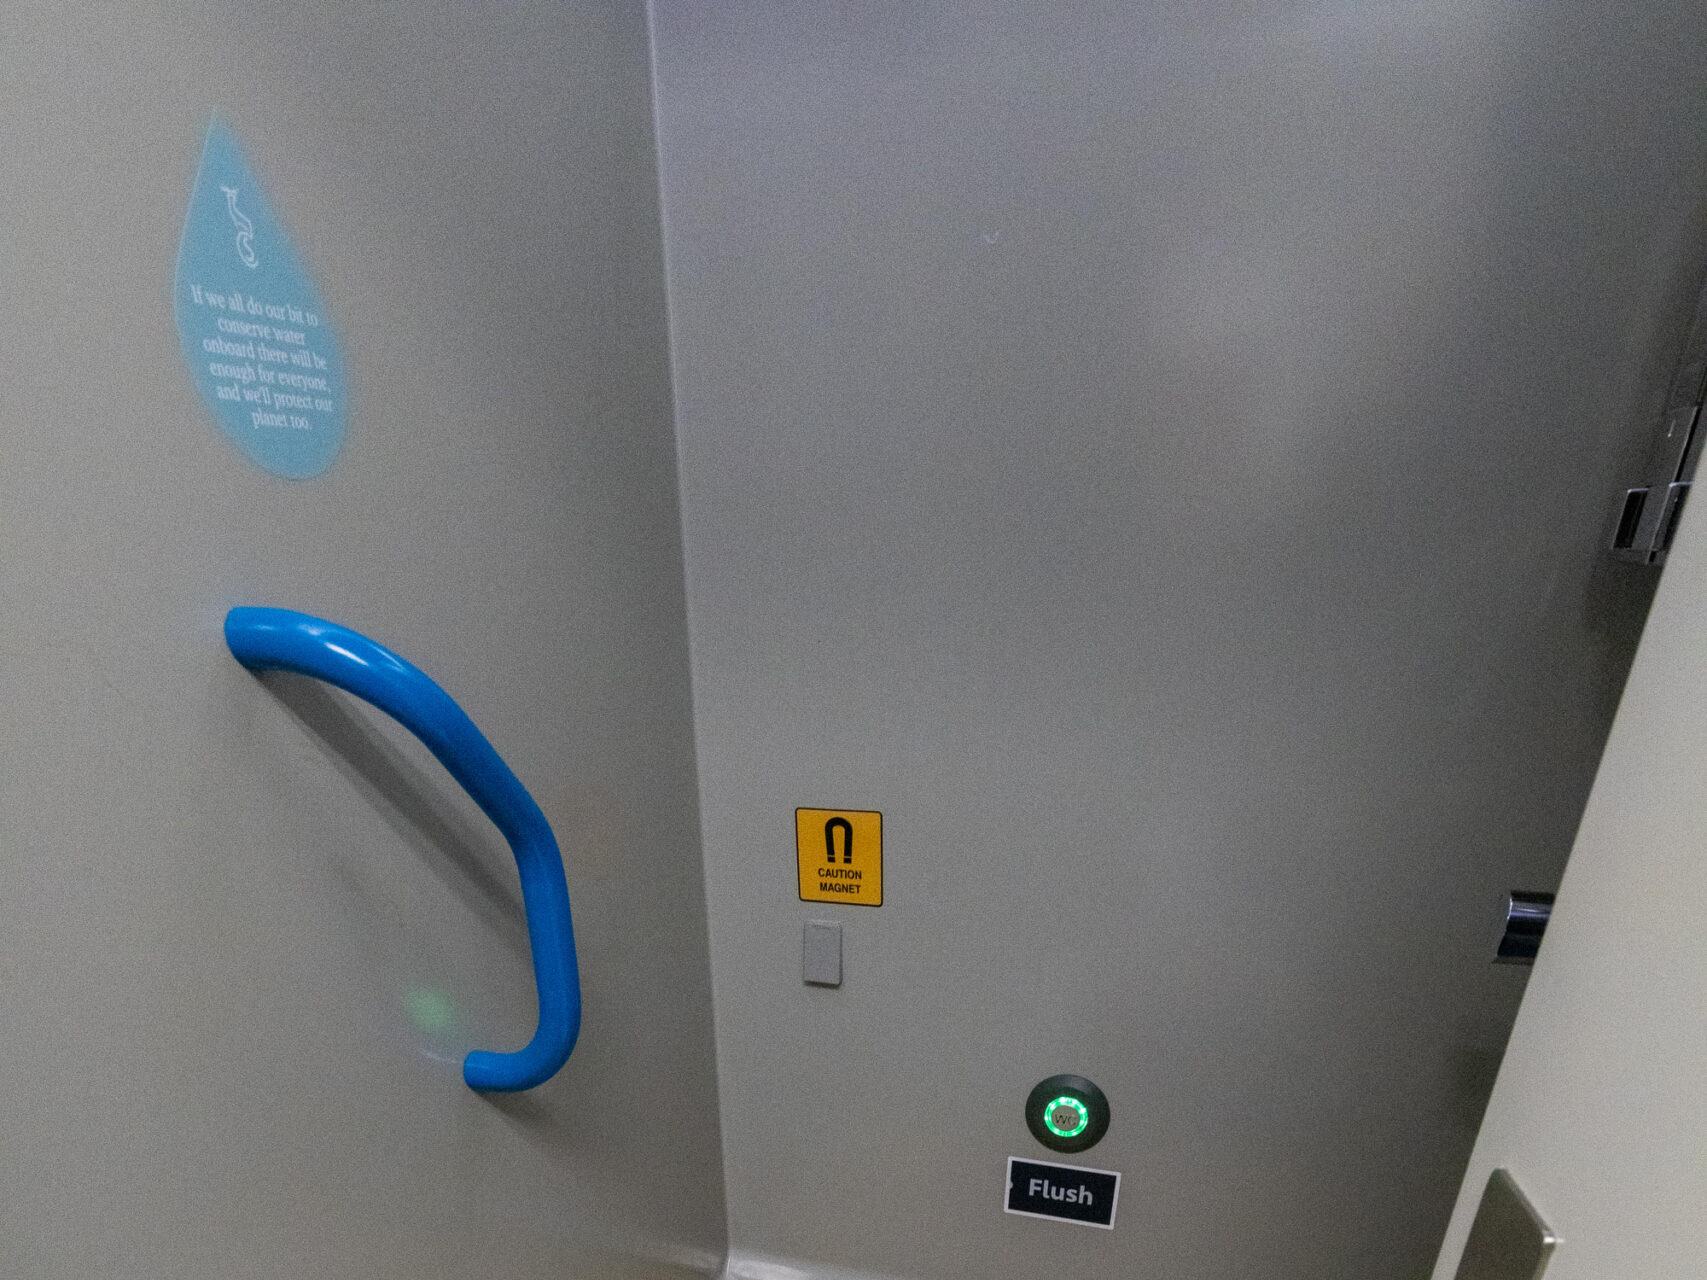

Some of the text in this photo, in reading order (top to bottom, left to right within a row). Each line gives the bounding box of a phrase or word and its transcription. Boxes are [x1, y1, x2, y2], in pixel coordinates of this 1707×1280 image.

[191, 284, 318, 326] If we all do our bit to
[217, 318, 305, 345] conserve water
[203, 335, 327, 370] onboard there will be
[209, 362, 256, 384] enough
[258, 364, 275, 384] for
[217, 383, 241, 400] and
[273, 392, 314, 410] protect
[314, 399, 333, 412] our
[252, 408, 288, 430] planet
[818, 867, 862, 880] CAUTION
[820, 882, 861, 894] MAGNET
[1055, 1113, 1077, 1127] WC
[1028, 1178, 1093, 1206] Flush
